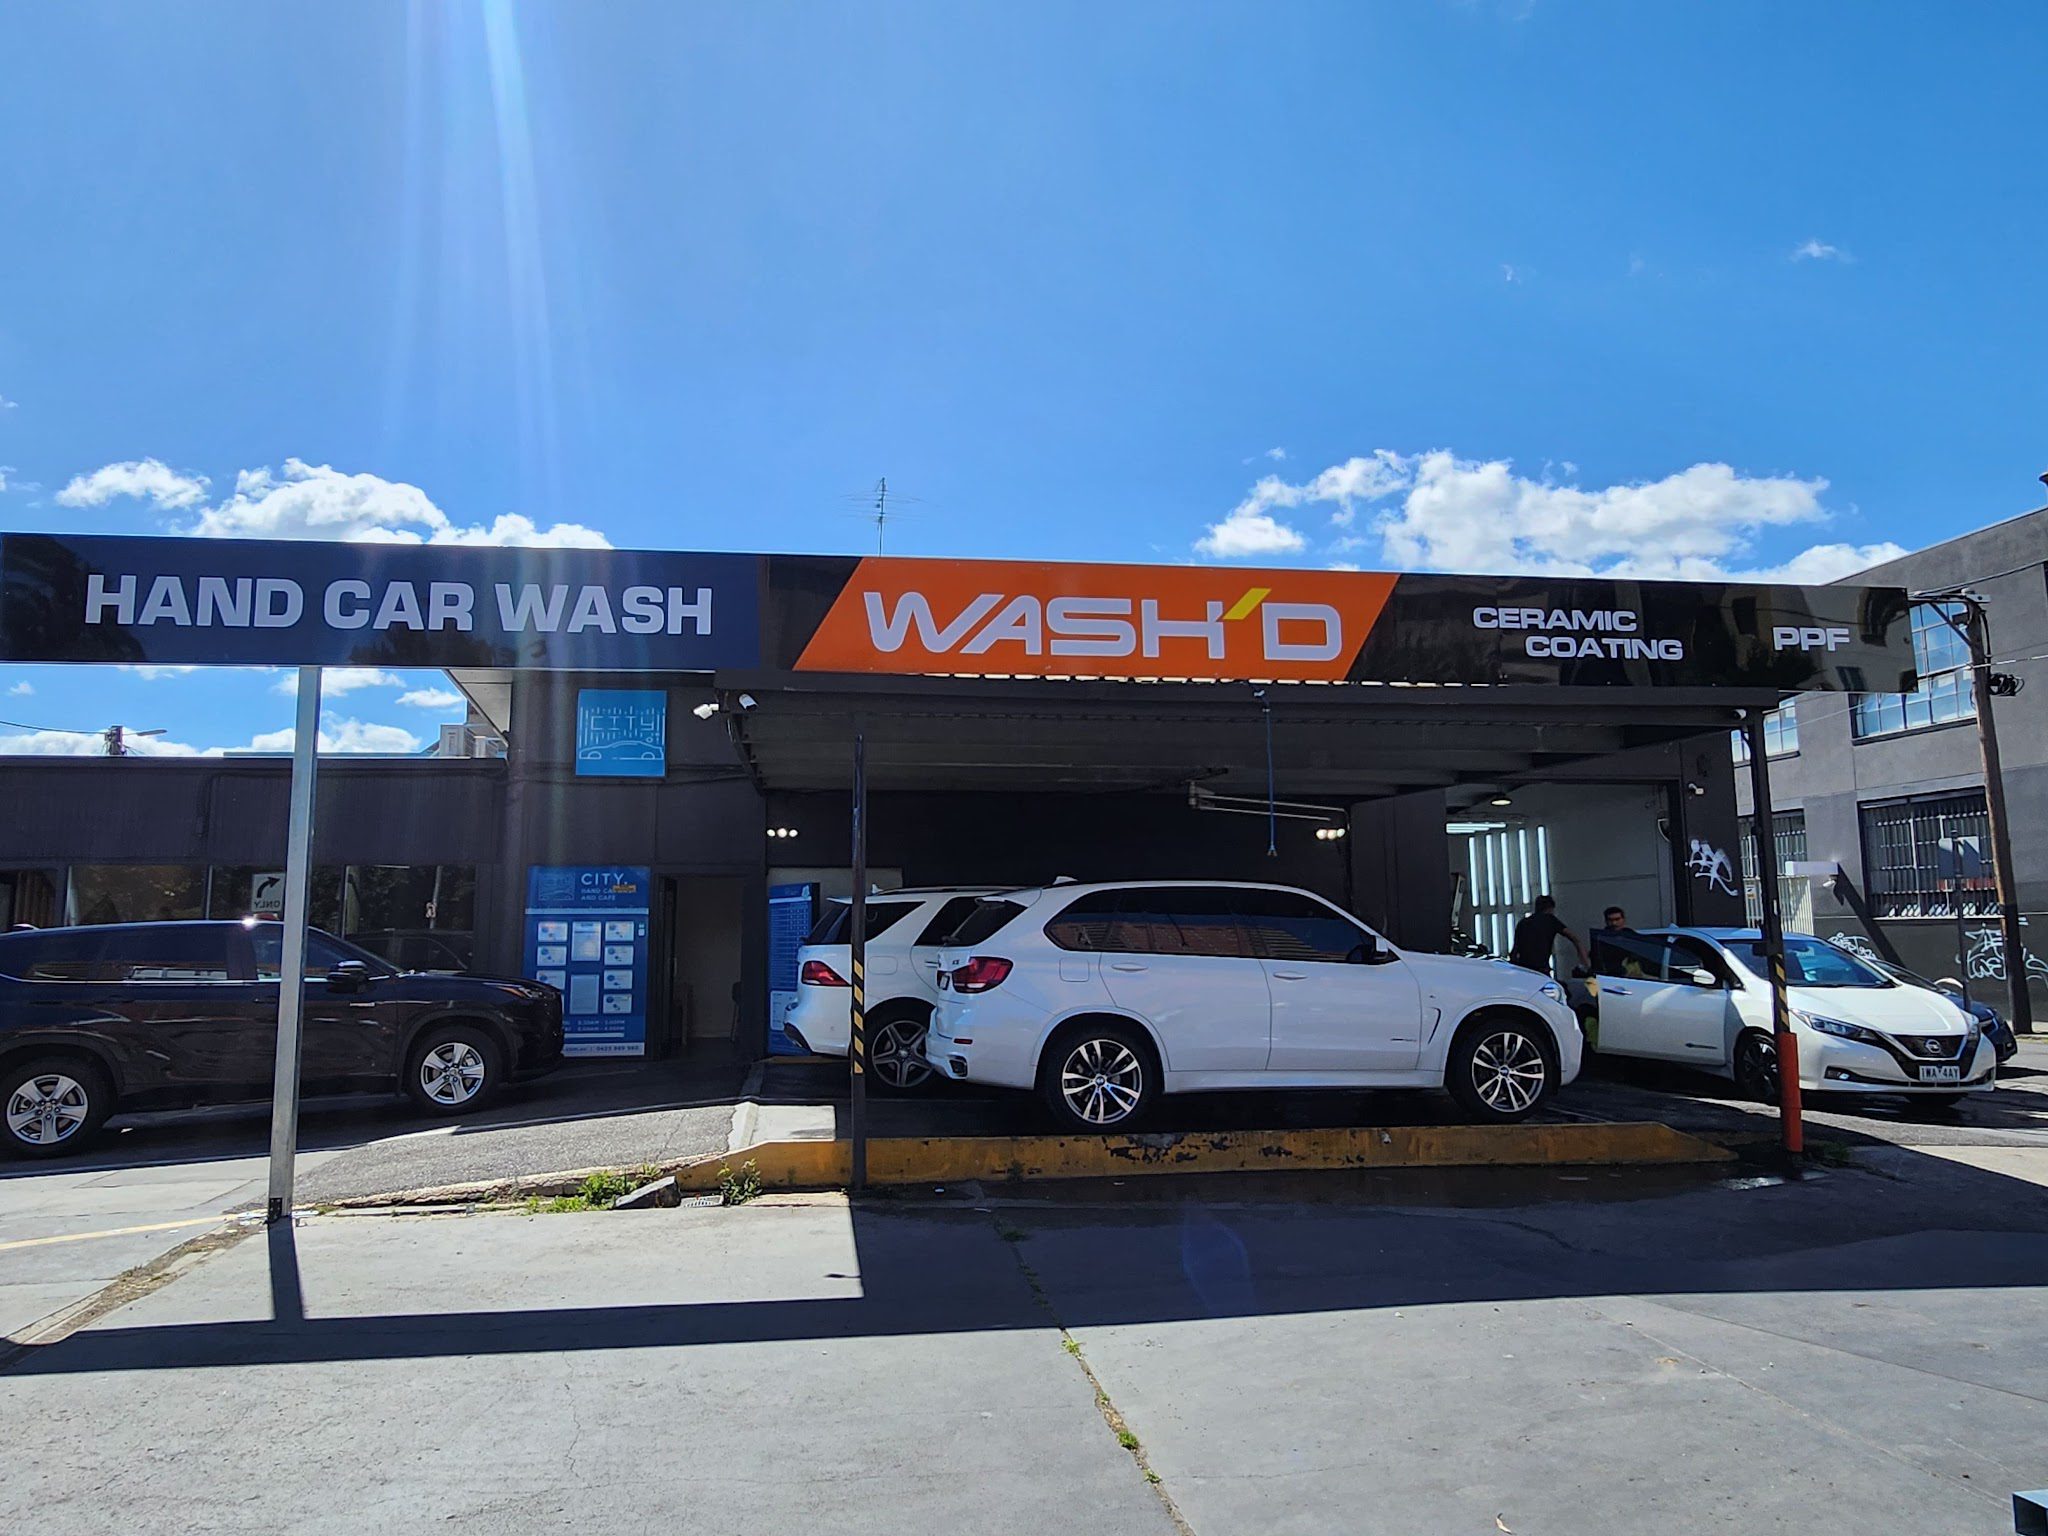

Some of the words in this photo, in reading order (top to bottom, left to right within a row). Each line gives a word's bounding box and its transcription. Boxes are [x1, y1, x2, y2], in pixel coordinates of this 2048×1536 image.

[85, 574, 304, 628] HAND
[324, 580, 475, 631] CAR
[495, 582, 713, 636] WASH
[863, 587, 1344, 662] WASH'D
[1473, 607, 1637, 632] CERAMIC
[1525, 636, 1683, 661] COATING
[1773, 627, 1850, 652] PPF
[590, 715, 654, 731] CITY
